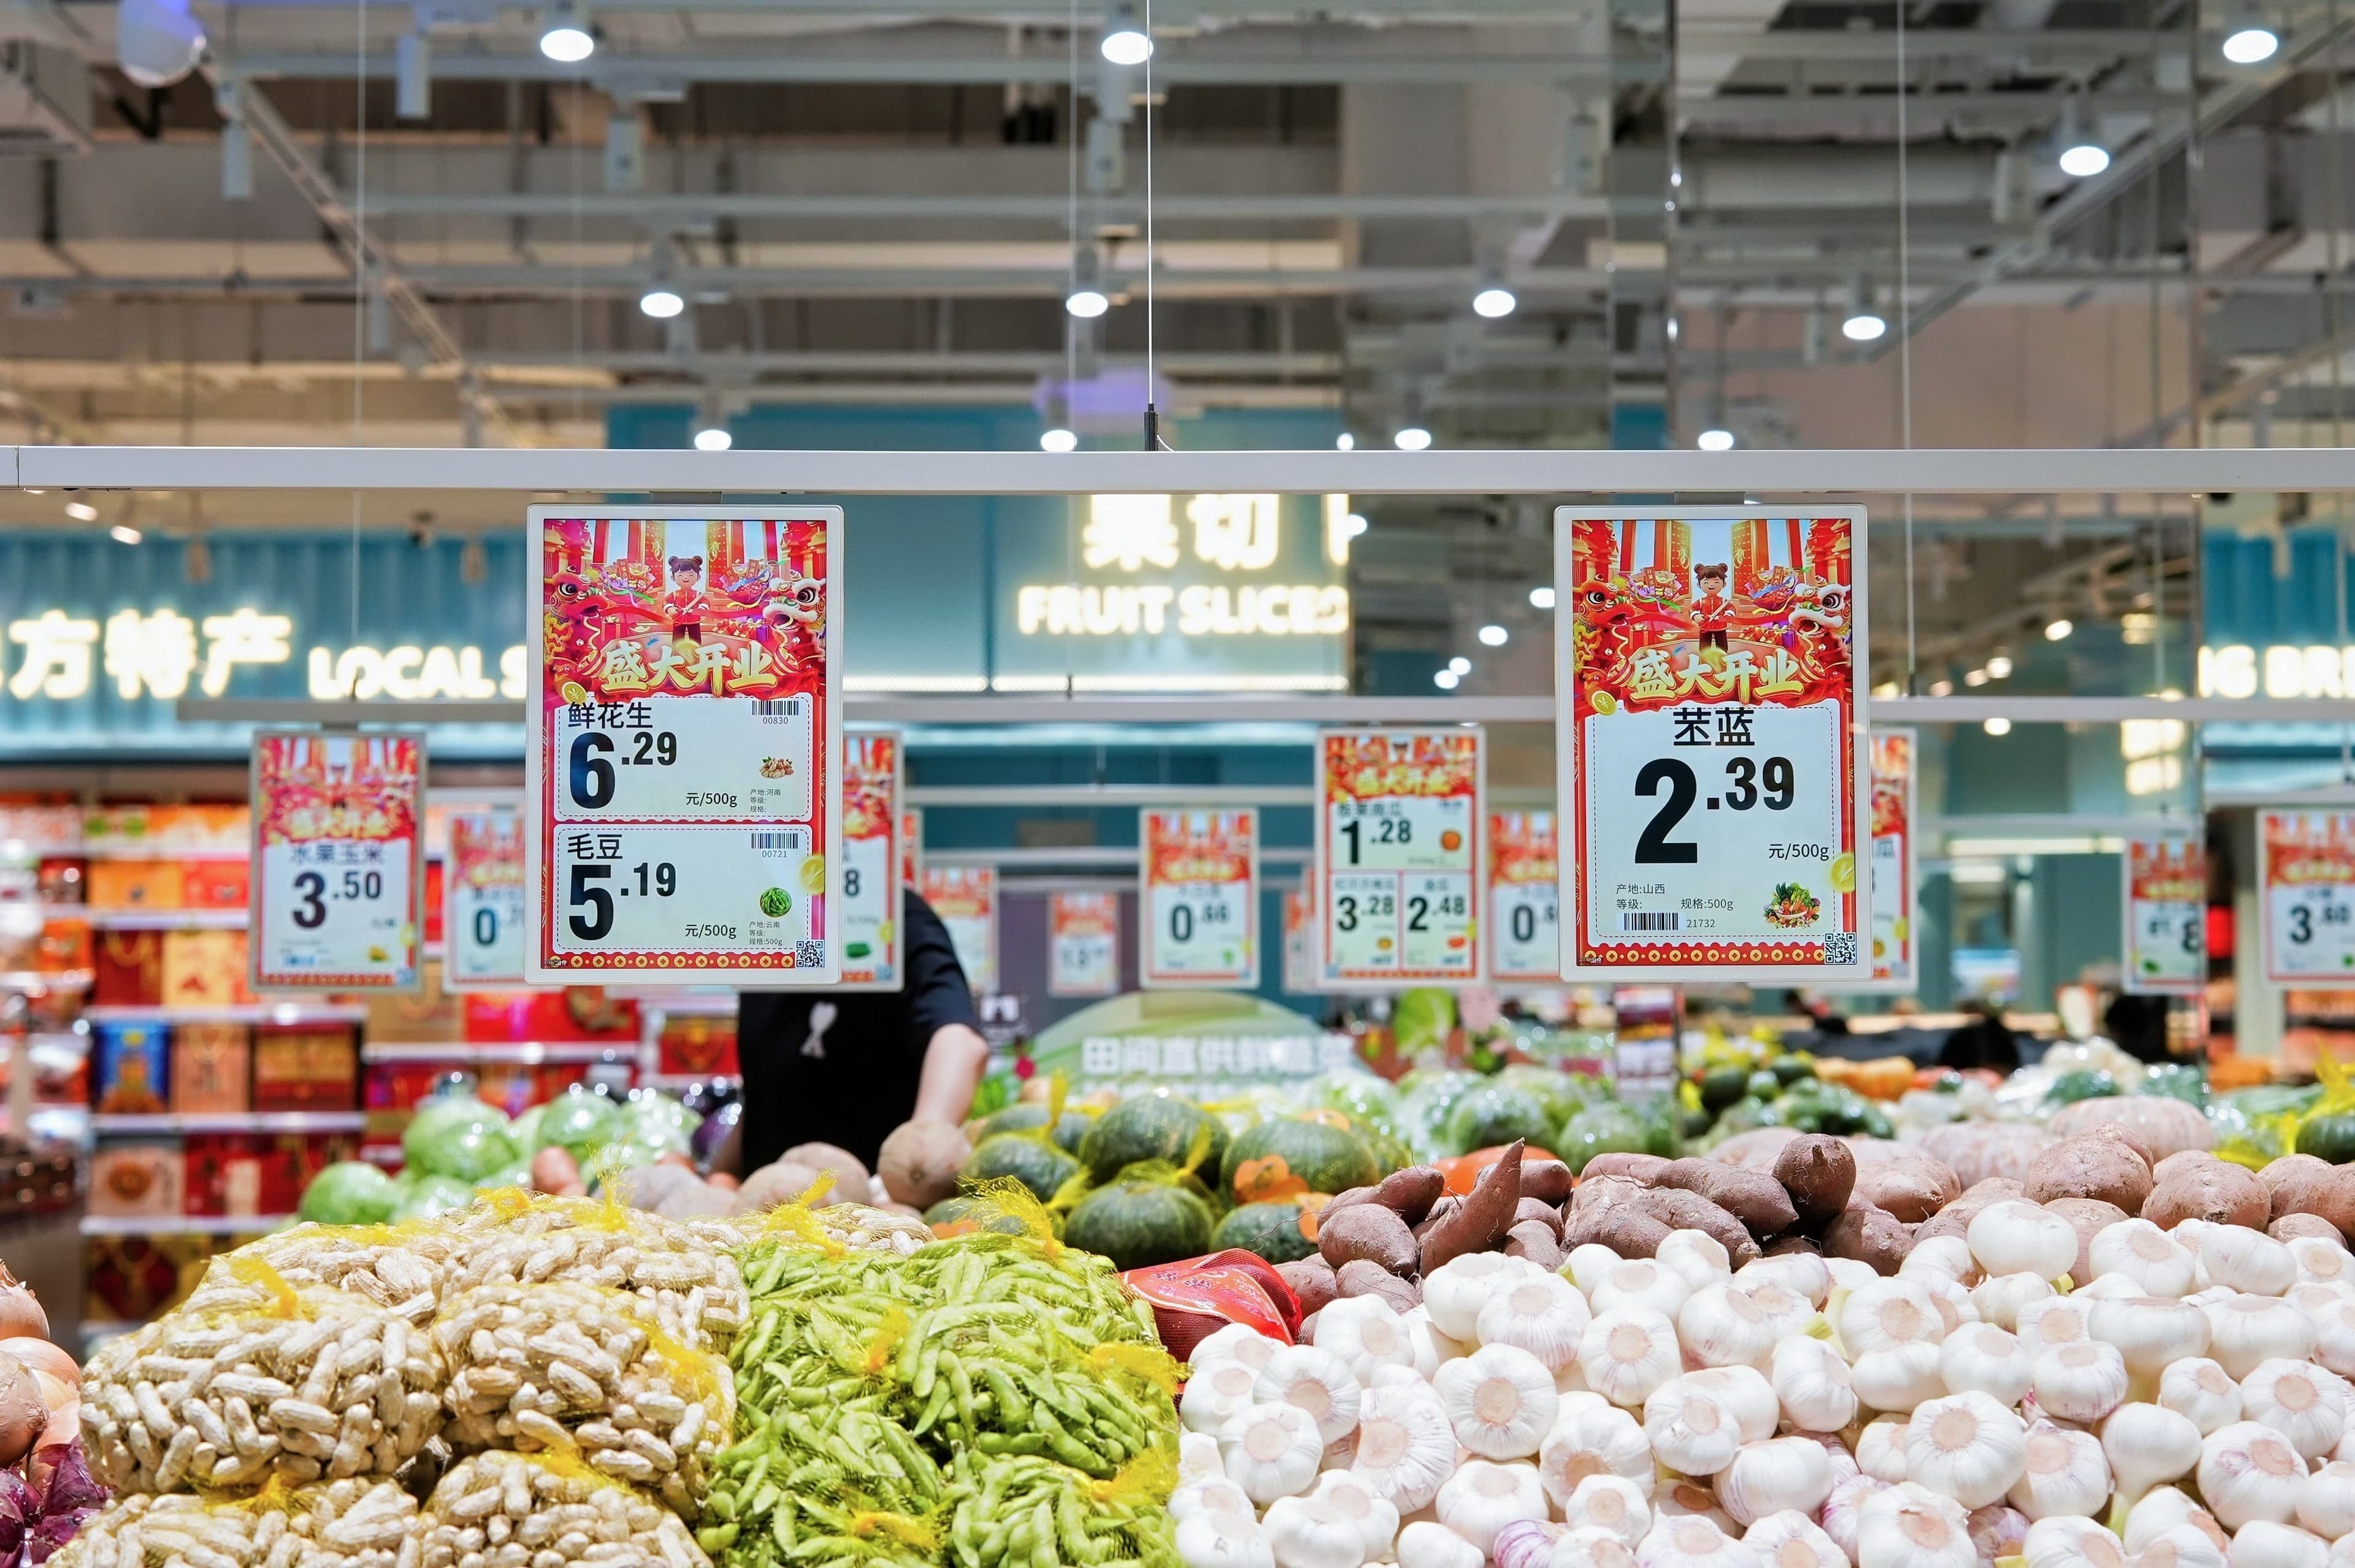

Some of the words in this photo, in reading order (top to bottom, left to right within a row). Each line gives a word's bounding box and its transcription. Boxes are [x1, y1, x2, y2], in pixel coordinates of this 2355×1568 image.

[1018, 585, 1174, 635] FRUIT
[0, 608, 291, 698] 方特产
[600, 639, 778, 698] 盛大开业
[308, 645, 496, 698] LOCAL
[1630, 648, 1804, 705] 盛大开业
[567, 701, 653, 729] 鲜花生
[762, 716, 789, 725] 00830
[1672, 706, 1756, 746] 苤蓝
[569, 732, 677, 809] 6.29
[686, 792, 738, 808] 元/500g
[1634, 756, 1795, 864] 2.39
[567, 832, 623, 860] 毛豆
[762, 849, 787, 858] 00721
[1340, 819, 1412, 866] 1.28
[1768, 843, 1830, 862] 元/500g
[292, 871, 382, 930] 3.50
[569, 862, 676, 941] 5.19
[1616, 883, 1666, 895] 产地:山西
[1616, 899, 1643, 910] 等级:
[1680, 898, 1734, 911] 规格:500g
[684, 924, 737, 939] 元/500g
[1687, 919, 1716, 928] 21732
[749, 938, 783, 946] 规格:500g
